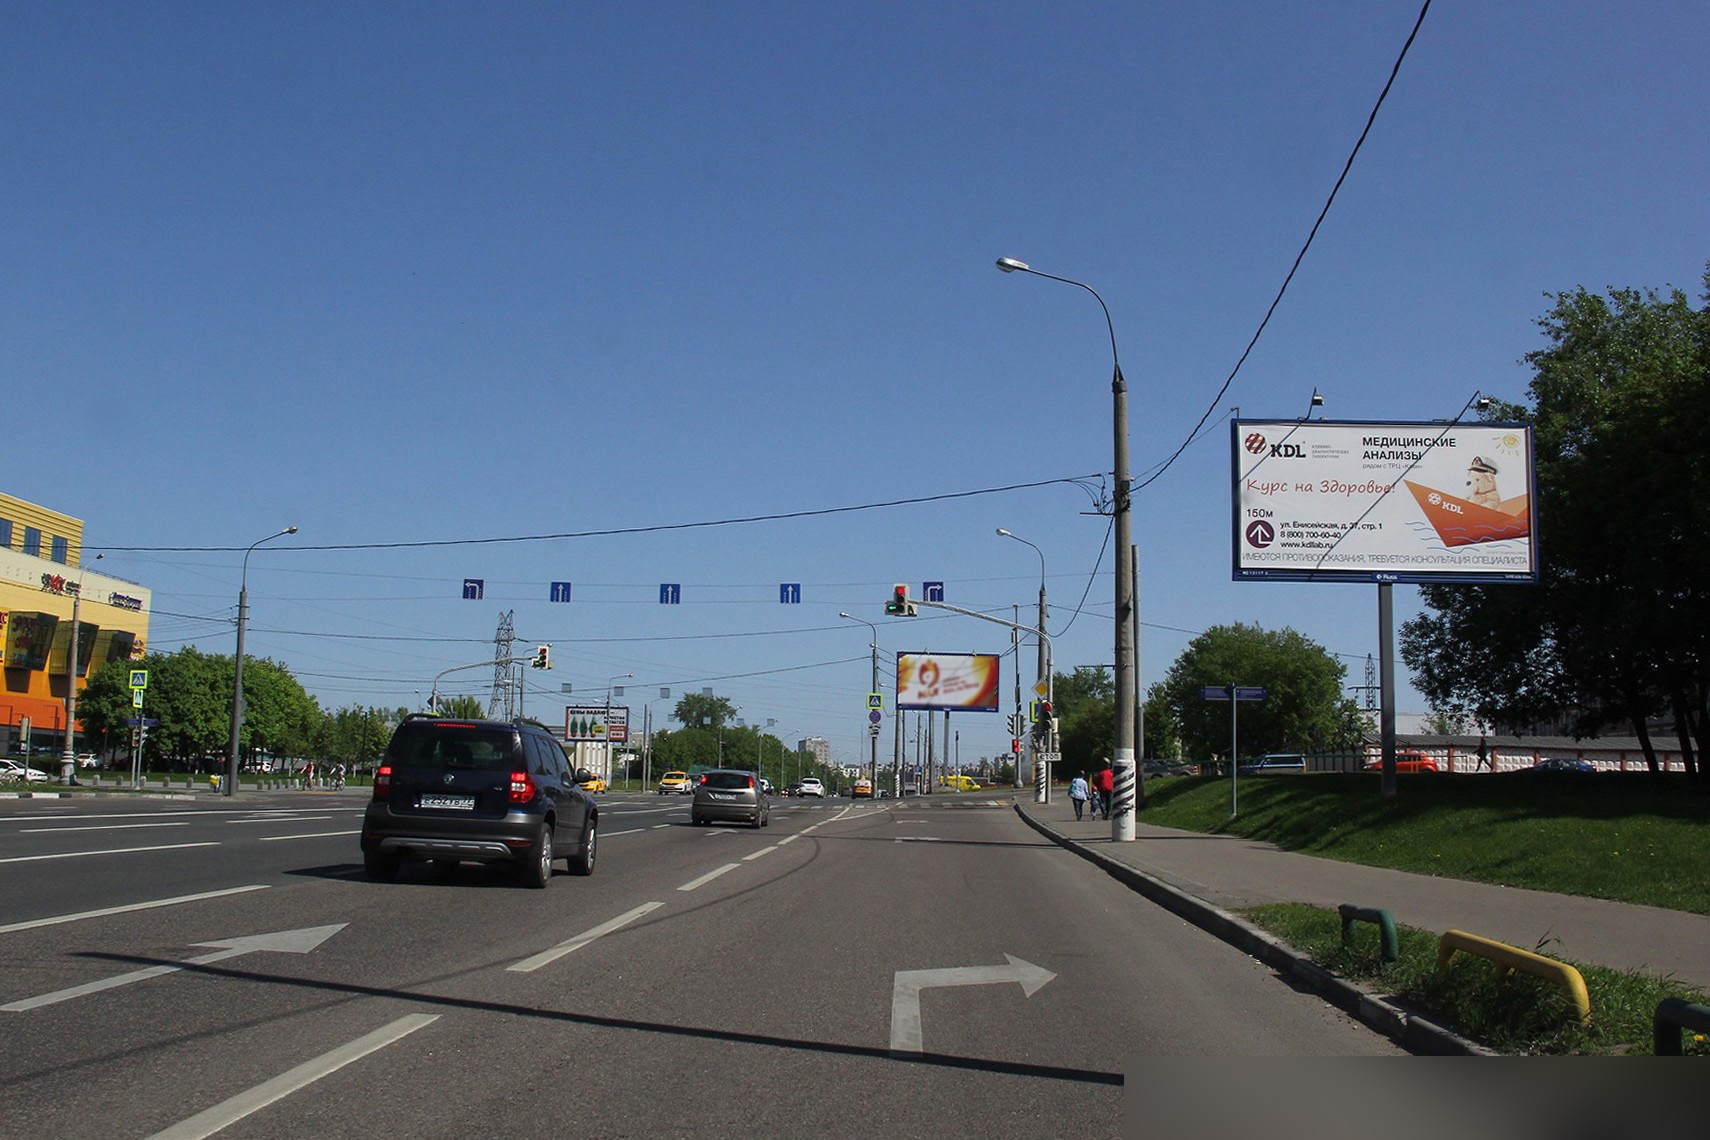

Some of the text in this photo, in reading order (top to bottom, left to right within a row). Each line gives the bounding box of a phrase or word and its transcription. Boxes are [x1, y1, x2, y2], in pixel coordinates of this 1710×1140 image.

[1362, 436, 1456, 448] МЕДИЦИНСКИЕ
[1270, 444, 1306, 458] KDL
[1362, 450, 1422, 460] АНАЛИЗЫ
[1246, 479, 1396, 496] Курс на Здоровье!
[1246, 508, 1273, 518] 150м
[1442, 502, 1464, 514] KDL
[1292, 522, 1339, 530] Енисейская,
[1242, 552, 1528, 564] ИМЕЮТСЯ ПРОТИВОПОКАЗАНИЯ, ТРЕБУЕТСЯ КОНСУЛЬТАЦИЯ СПЕЦИАЛИСТА
